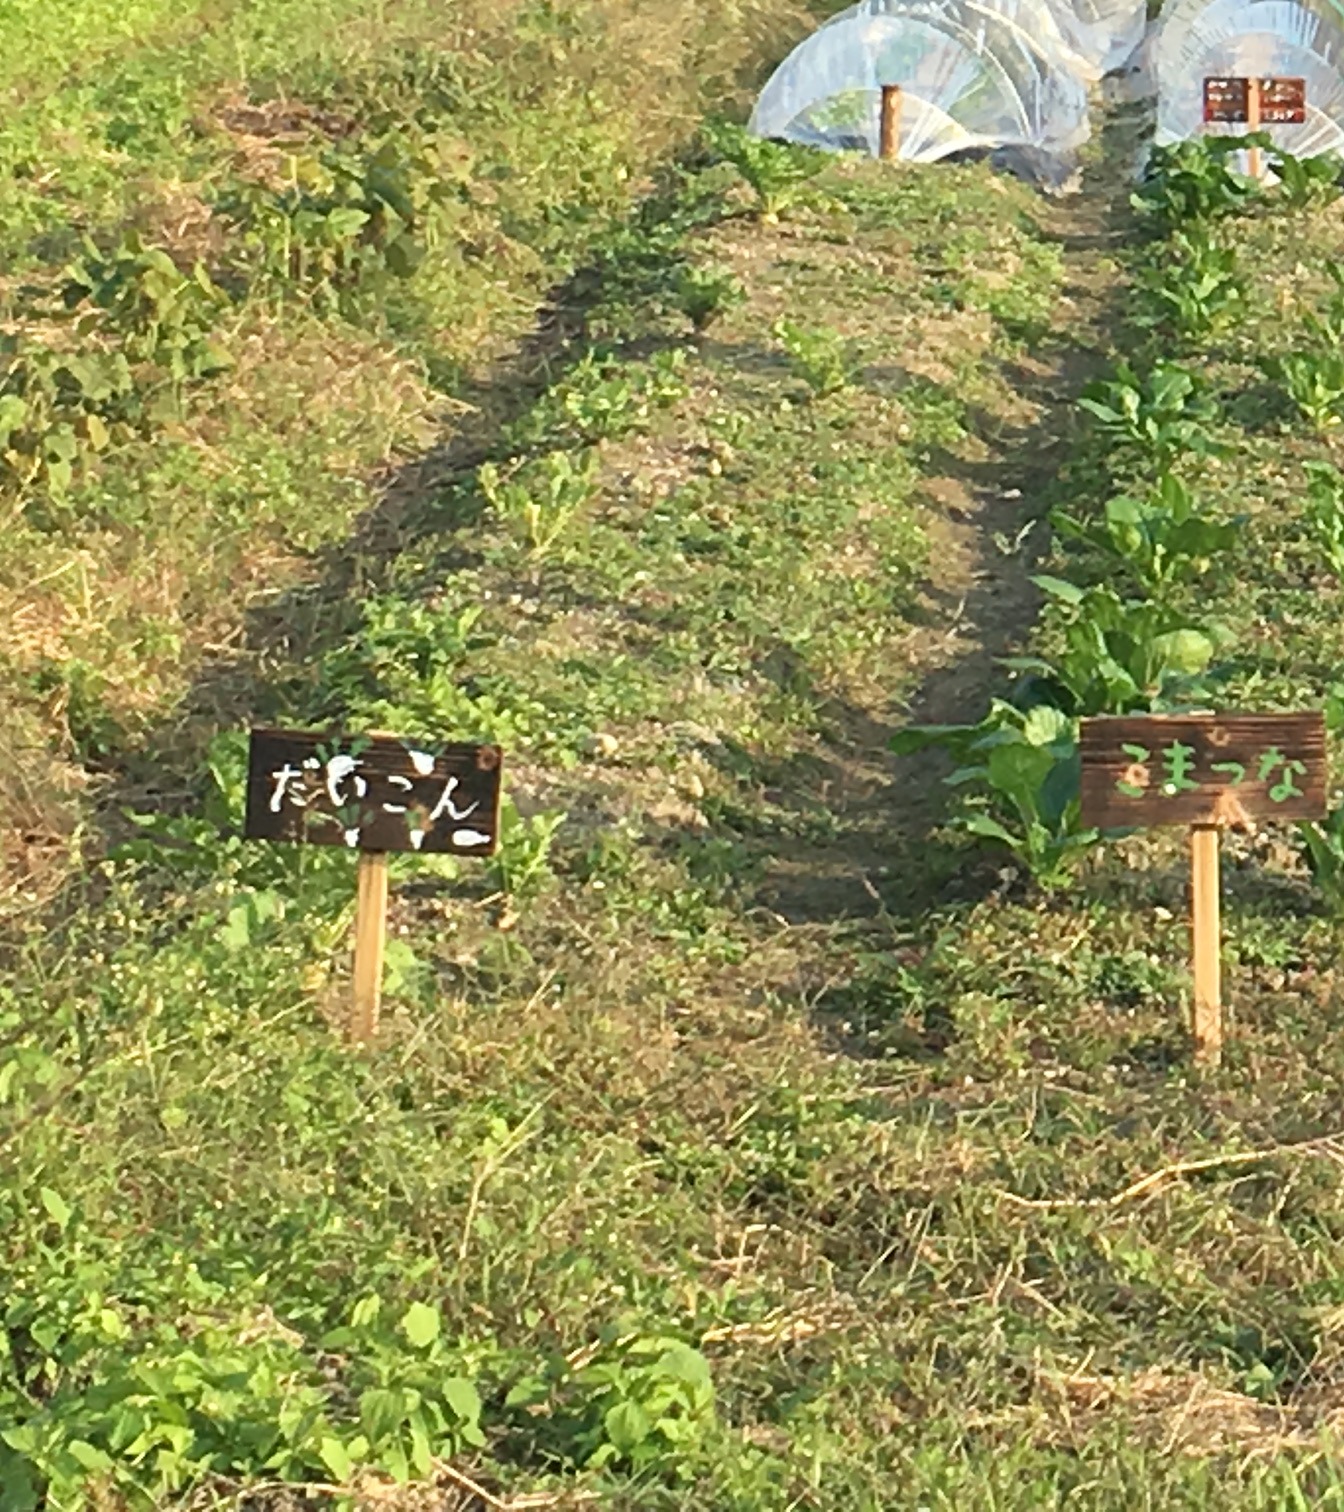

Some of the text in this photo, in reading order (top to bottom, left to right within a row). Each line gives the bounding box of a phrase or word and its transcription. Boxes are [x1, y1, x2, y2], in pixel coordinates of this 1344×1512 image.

[270, 755, 480, 821] だいこん
[1116, 739, 1308, 802] こまつな
